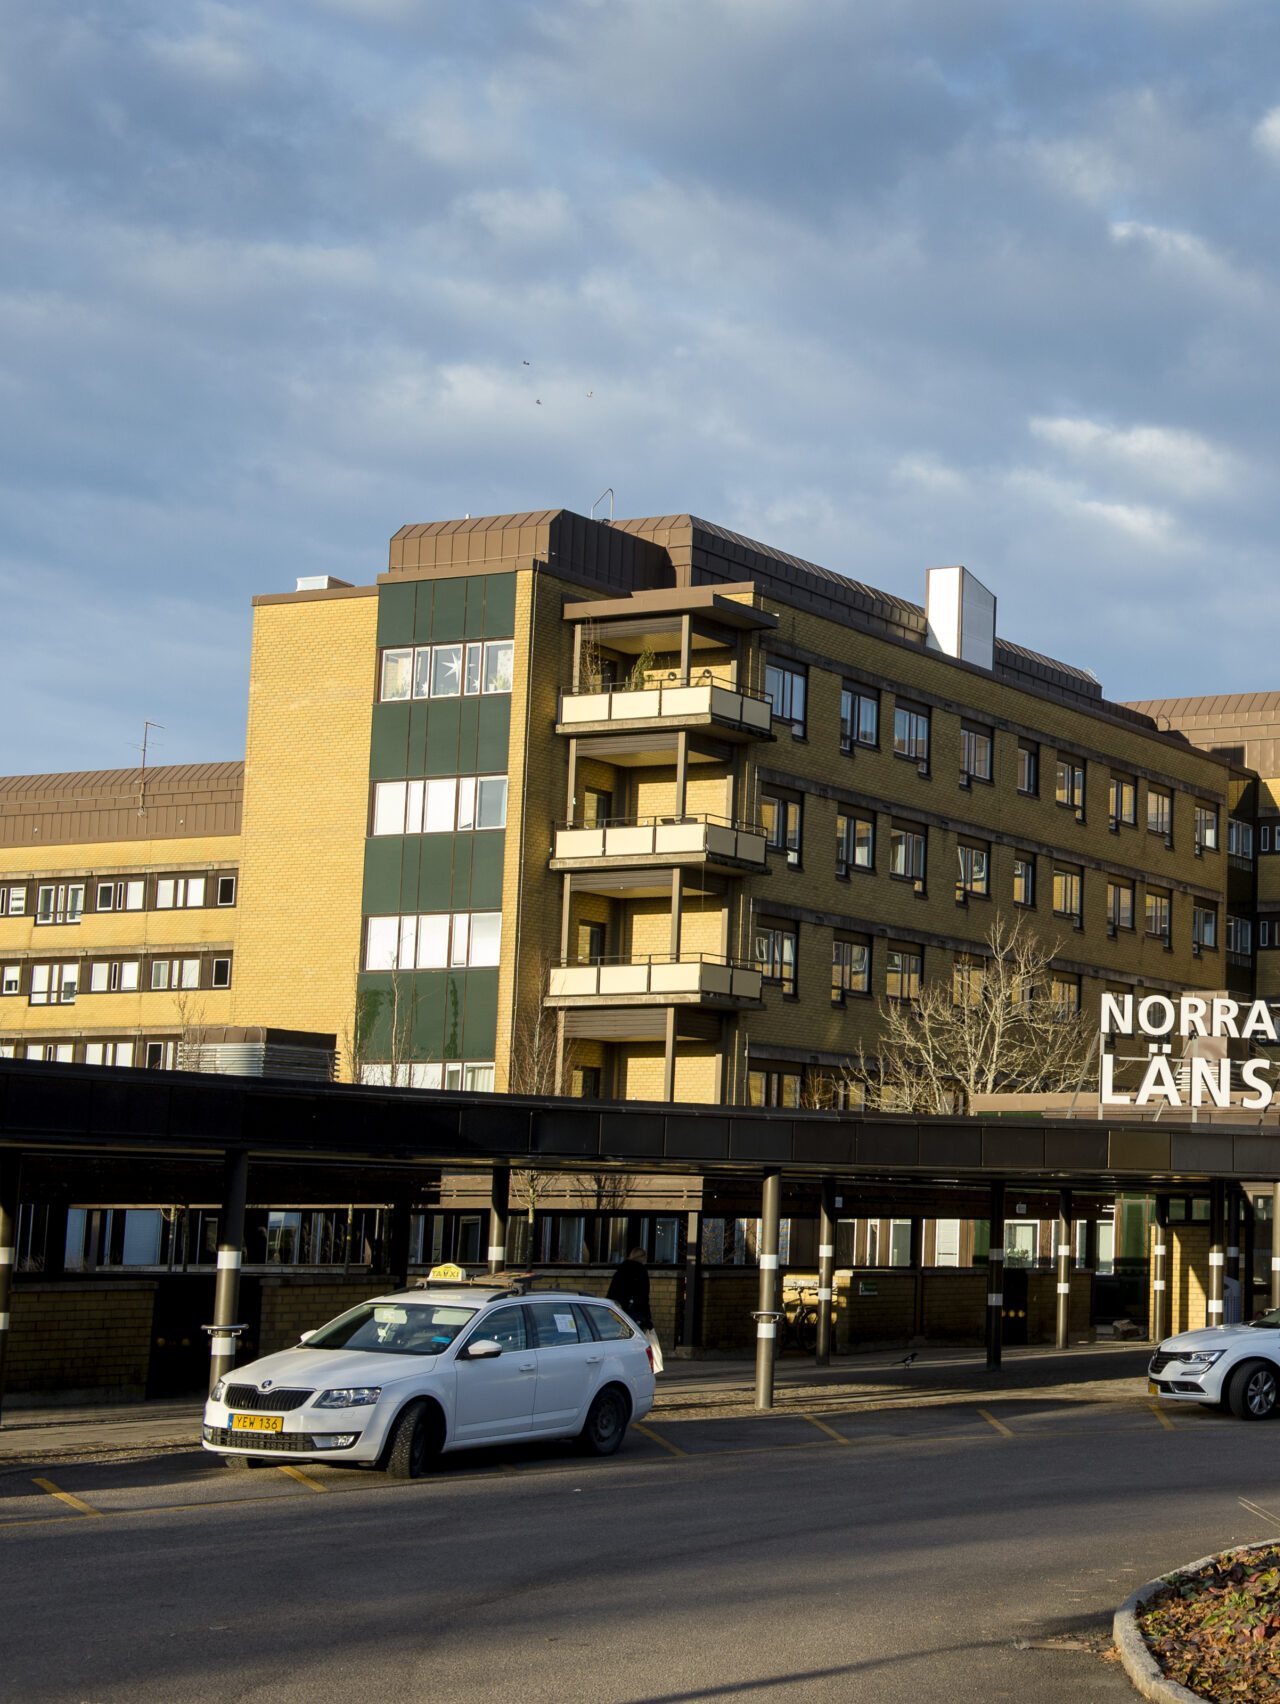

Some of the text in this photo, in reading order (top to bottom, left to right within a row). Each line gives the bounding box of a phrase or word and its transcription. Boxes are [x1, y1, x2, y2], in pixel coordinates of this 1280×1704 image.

[1100, 993, 1278, 1040] NORRA
[237, 1416, 278, 1430] YEW 136
